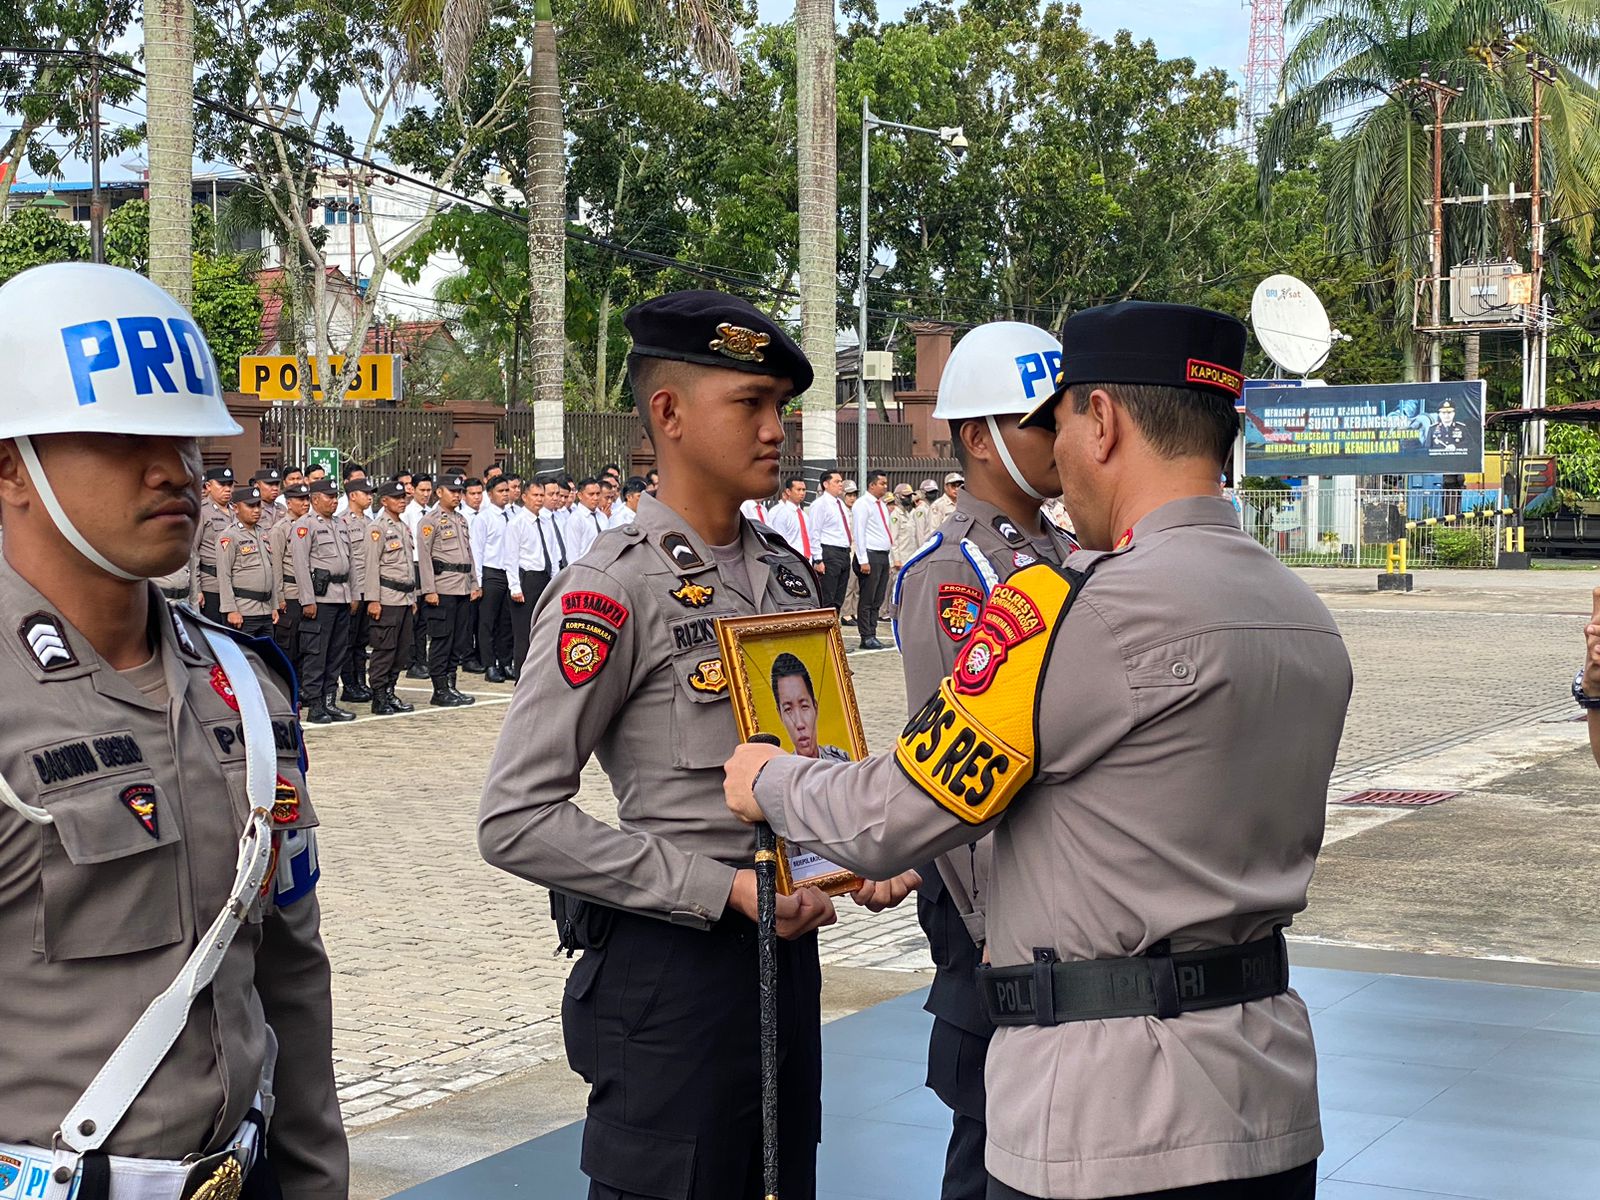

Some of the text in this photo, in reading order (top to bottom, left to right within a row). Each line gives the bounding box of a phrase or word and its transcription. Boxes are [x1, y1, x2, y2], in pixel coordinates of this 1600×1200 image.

[1308, 417, 1338, 430] SUATU
[1309, 442, 1340, 454] SUATU
[1344, 440, 1400, 454] KEMULIAAN
[944, 585, 979, 597] PROPAM
[565, 595, 623, 622] SAT SAMAPTA
[993, 586, 1040, 630] POLRESTA
[213, 719, 300, 755] PRI
[931, 726, 1010, 807] RES
